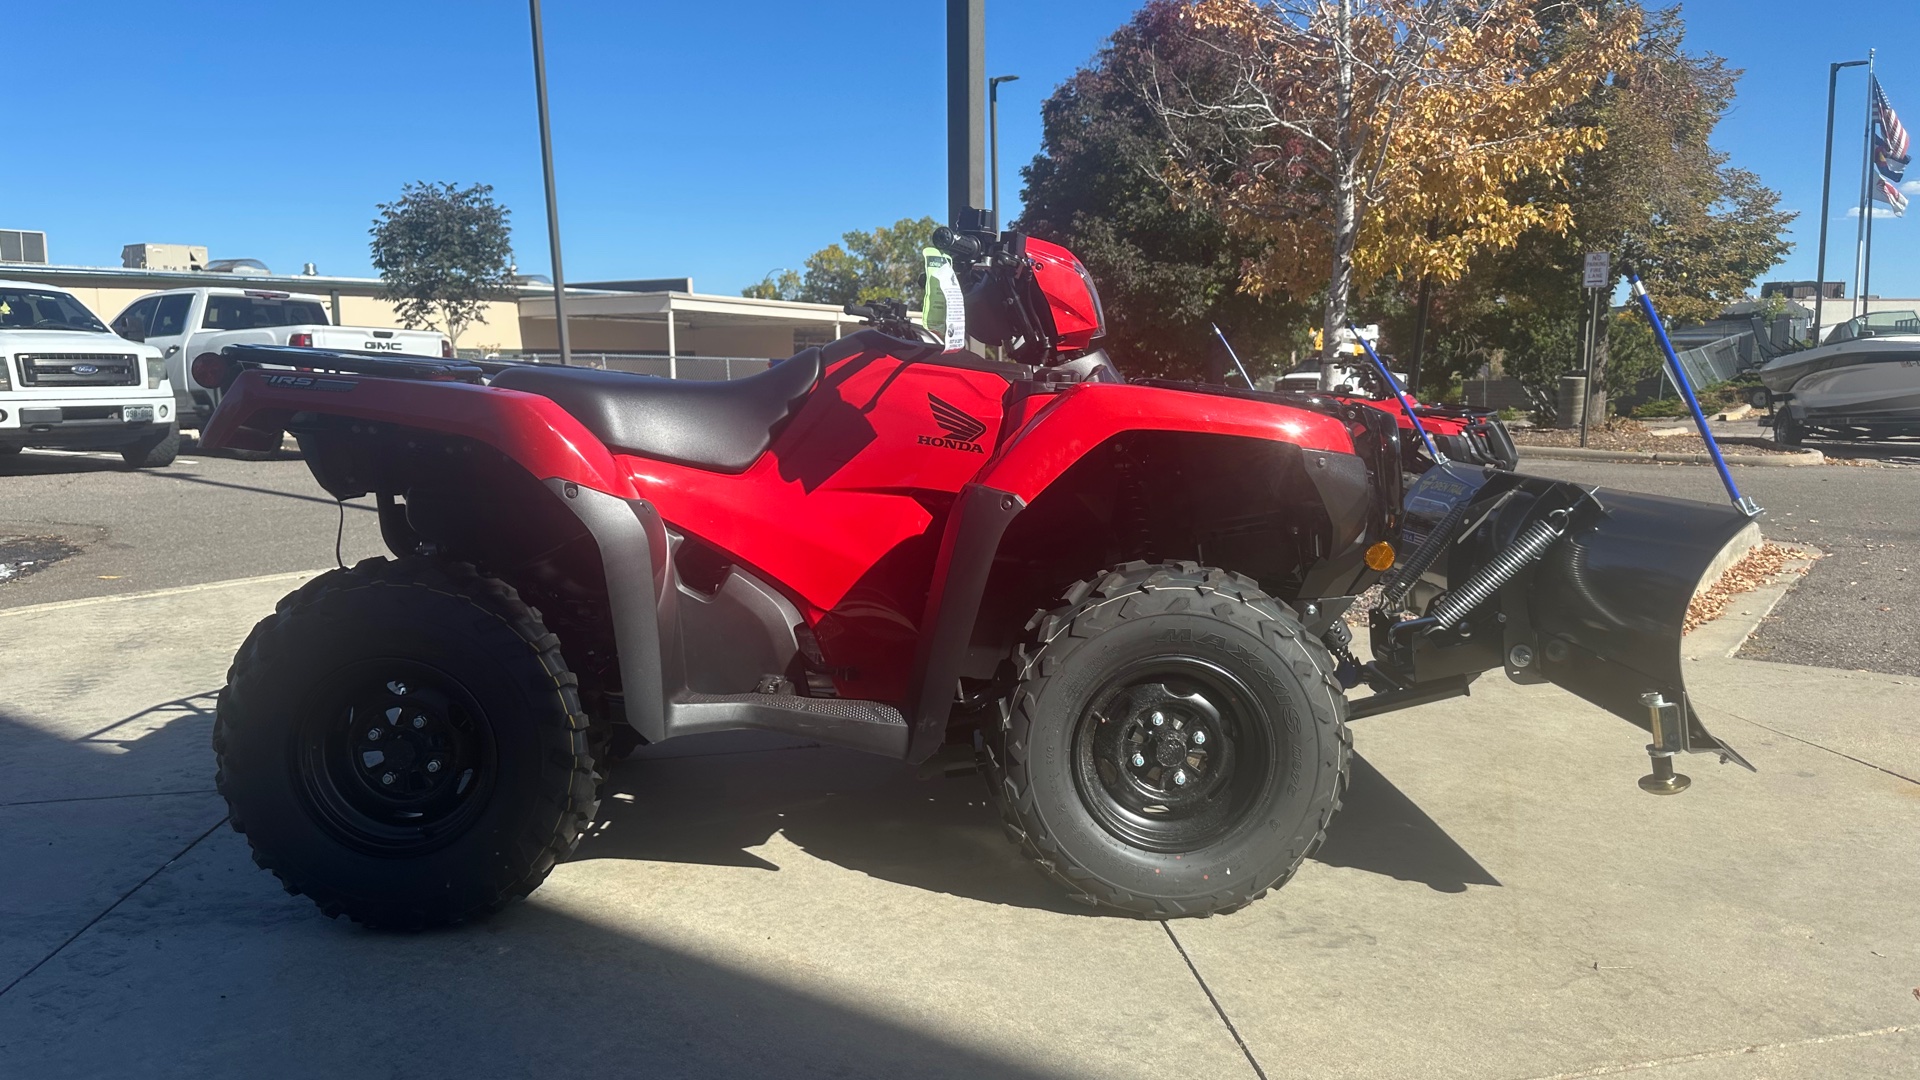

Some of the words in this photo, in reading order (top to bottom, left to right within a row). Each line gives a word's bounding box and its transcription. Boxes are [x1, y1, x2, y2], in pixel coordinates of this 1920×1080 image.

[364, 341, 403, 351] GMC
[270, 375, 314, 386] IRS
[917, 435, 984, 454] HONDA
[1156, 628, 1302, 735] MAXXIS
